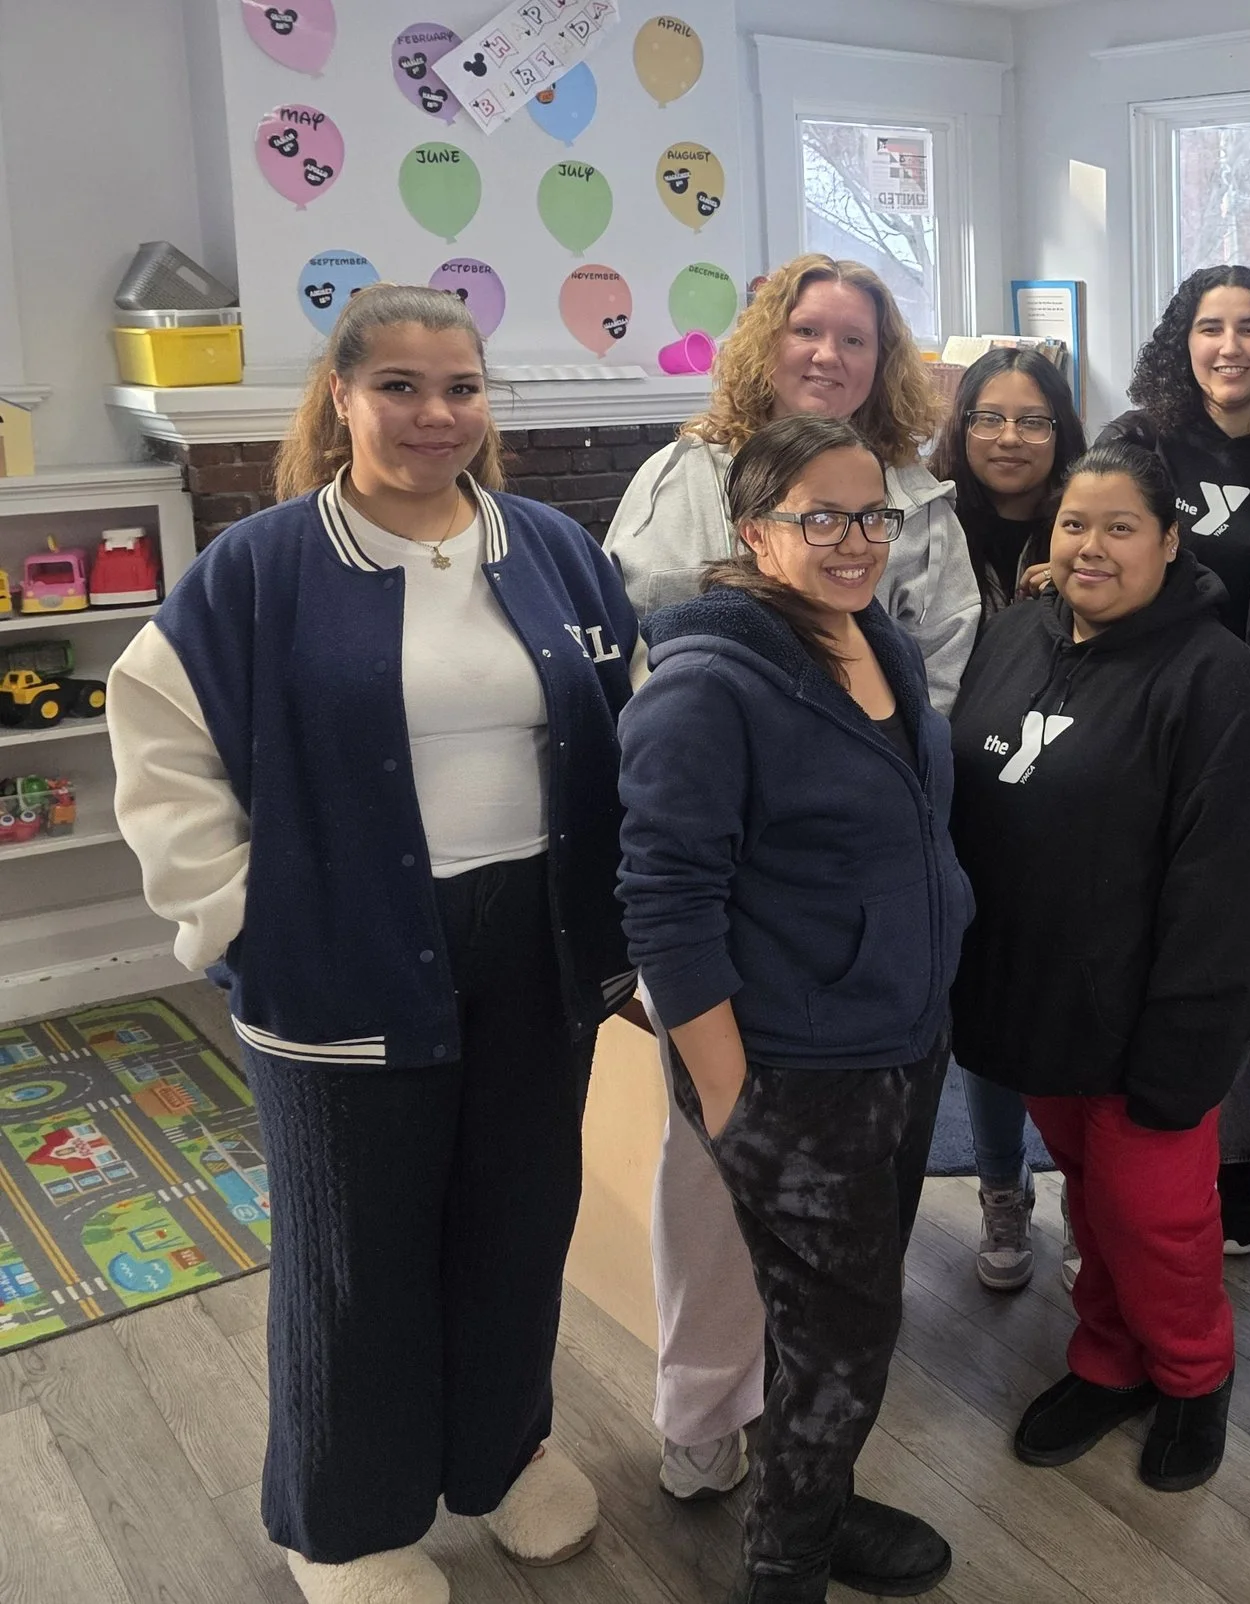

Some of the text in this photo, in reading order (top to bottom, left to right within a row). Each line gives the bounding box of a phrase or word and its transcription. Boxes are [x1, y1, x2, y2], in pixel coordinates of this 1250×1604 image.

[657, 17, 691, 38] APRIL
[397, 31, 454, 45] FEBRUARY
[280, 108, 325, 131] MAY
[416, 150, 460, 163] JUNE
[667, 150, 711, 163] AUGUST
[558, 164, 595, 182] JULY
[309, 257, 368, 267] SEPTEMBER
[441, 263, 492, 274] OCTOBER
[571, 271, 621, 281] NOVEMBER
[688, 265, 730, 281] DECEMBER
[1175, 497, 1198, 516] the
[983, 734, 1009, 755] the
[1019, 764, 1036, 785] YMCA
